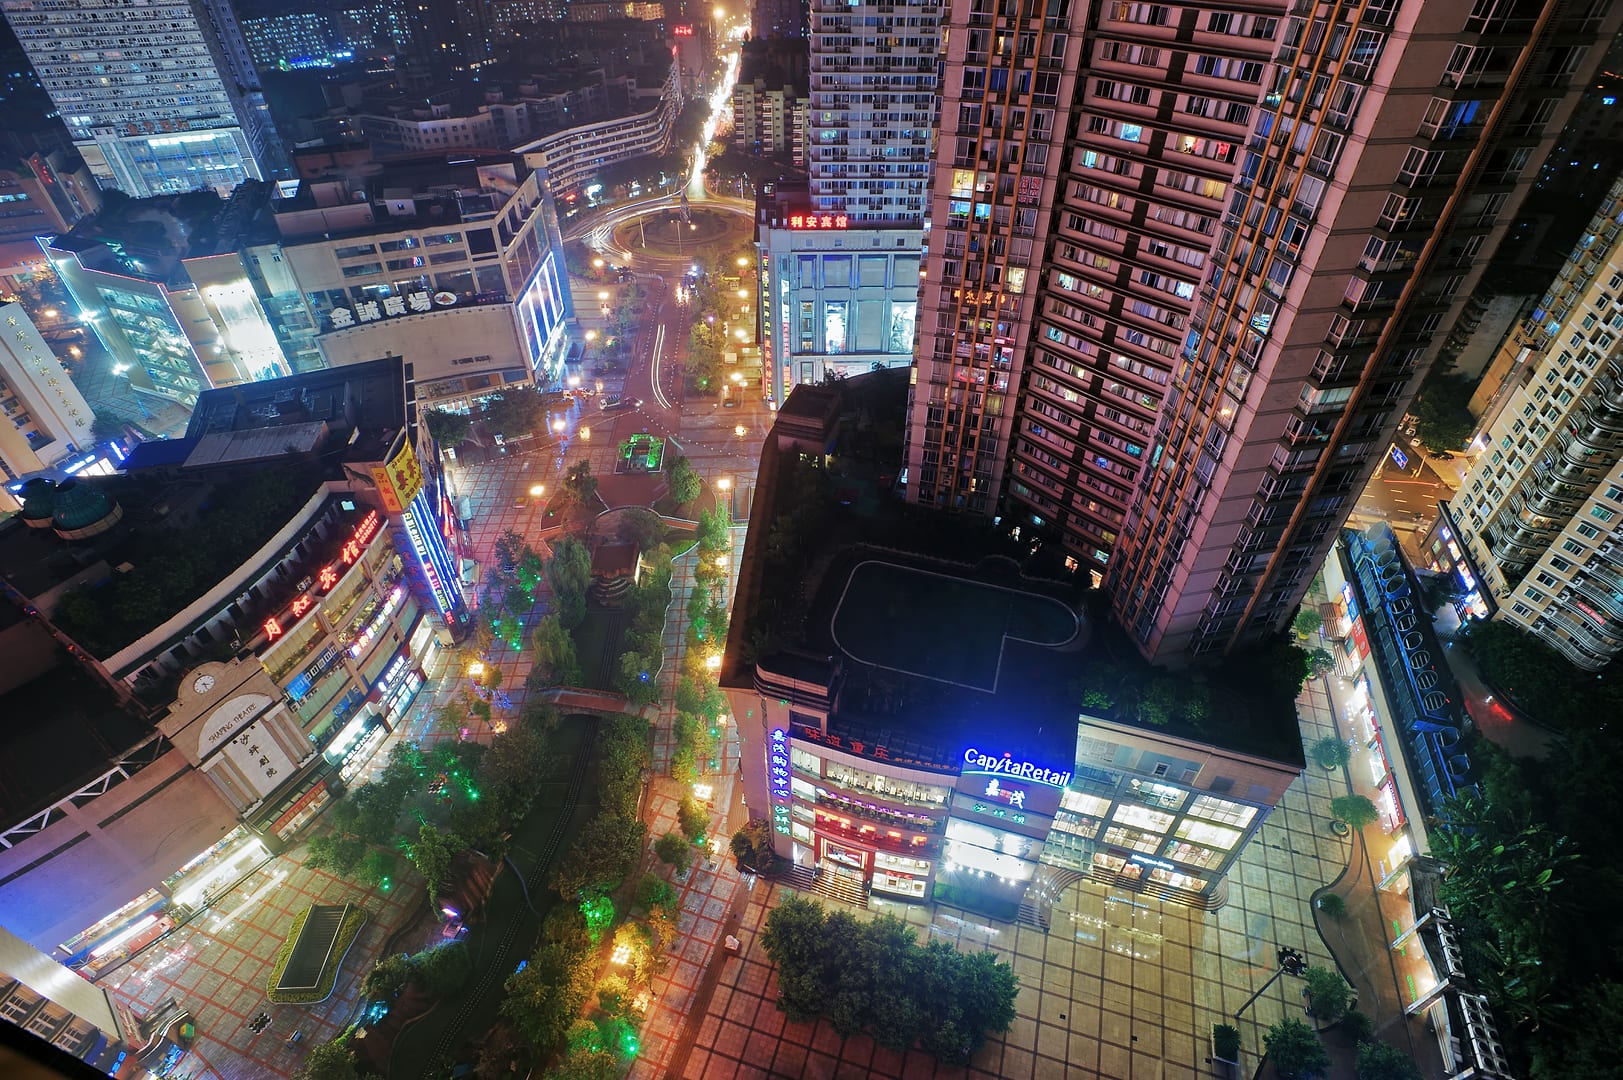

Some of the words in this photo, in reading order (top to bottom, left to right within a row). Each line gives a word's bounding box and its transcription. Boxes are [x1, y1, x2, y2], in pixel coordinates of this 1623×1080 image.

[790, 216, 848, 228] 利安宾馆
[208, 721, 233, 743] SHAPING
[233, 703, 257, 724] THEATRE
[964, 748, 1071, 787] CapitaRetail
